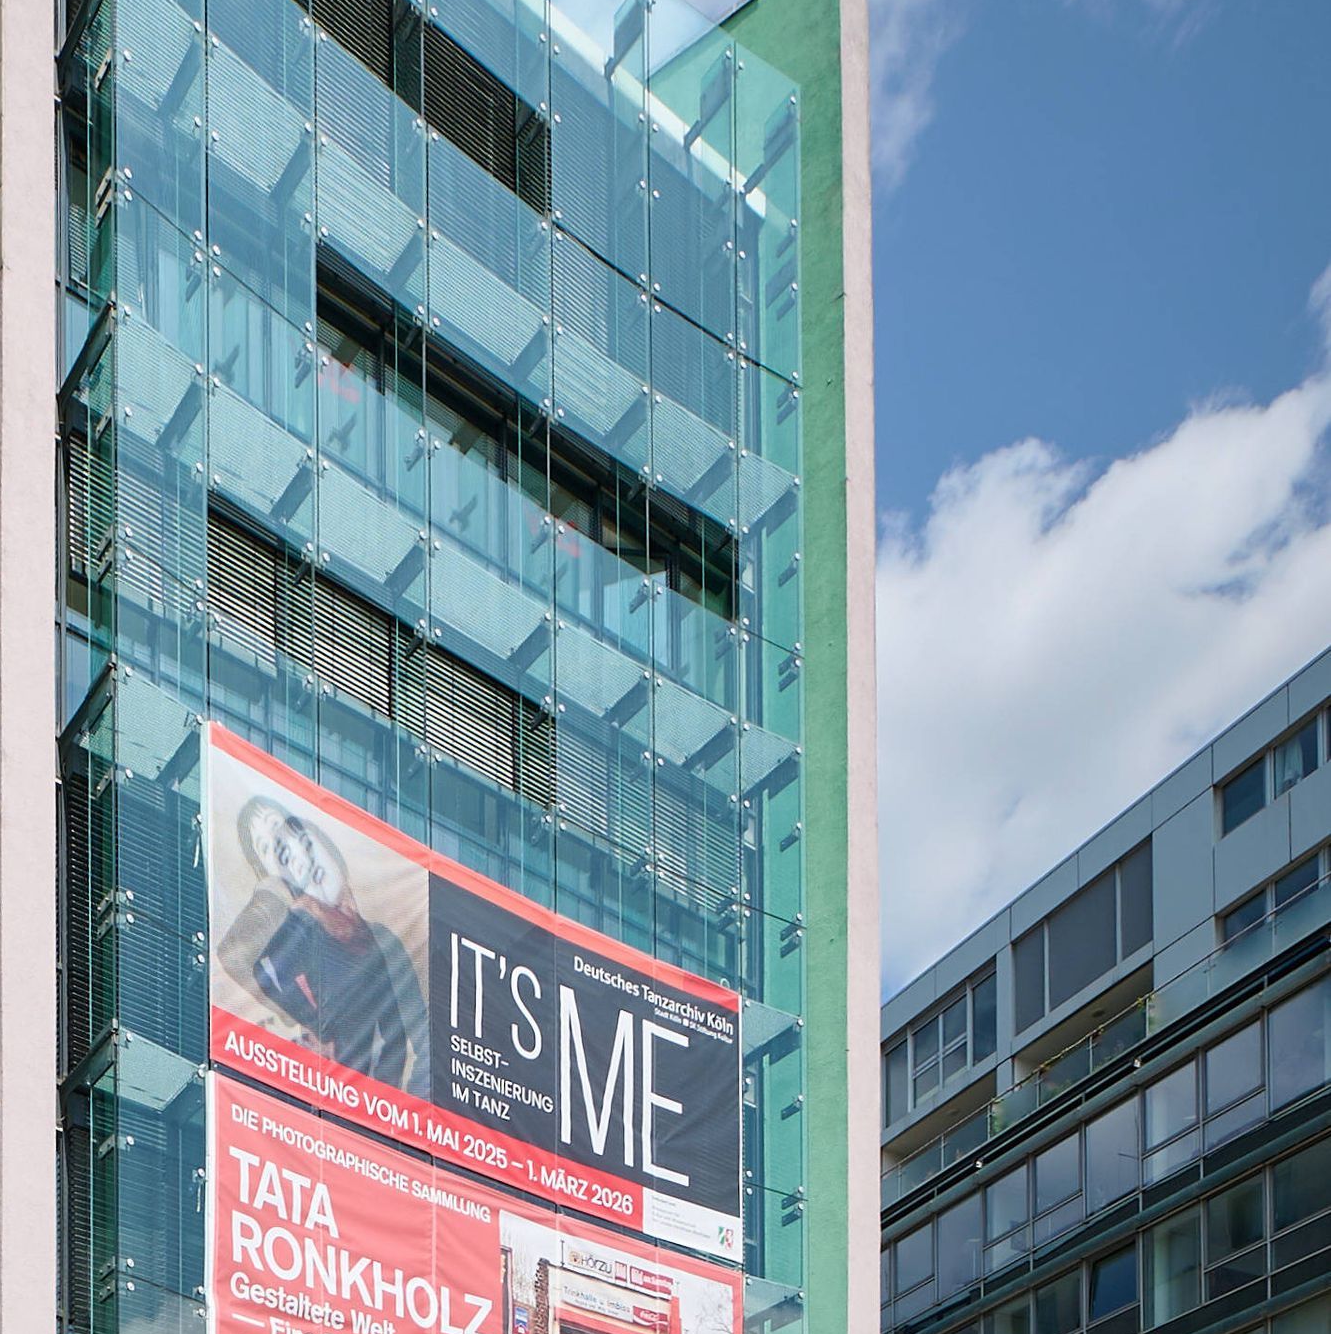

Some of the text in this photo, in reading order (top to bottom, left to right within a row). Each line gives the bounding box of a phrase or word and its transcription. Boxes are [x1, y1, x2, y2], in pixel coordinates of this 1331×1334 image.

[450, 931, 543, 1061] IT'S
[573, 955, 734, 1036] Deutsches Tanzarchiv Köln
[450, 1034, 510, 1069] SELBST-
[451, 1057, 554, 1113] INSZENIERUNG
[559, 983, 690, 1188] ME
[224, 1030, 360, 1109] AUSSTELLUNG
[362, 1091, 409, 1130] VOM
[411, 1112, 424, 1137] 1.
[426, 1118, 460, 1151] MAI
[462, 1134, 508, 1170] 2025
[526, 1159, 538, 1182] 1.
[540, 1166, 589, 1201] MÄRZ
[591, 1183, 634, 1216] 2026
[451, 1082, 511, 1121] IM TANZ
[228, 1146, 341, 1239] TATA
[230, 1103, 492, 1224] DIE PHOTOGRAPHISCHE SAMMLUNG
[229, 1271, 346, 1330] Gestaltete
